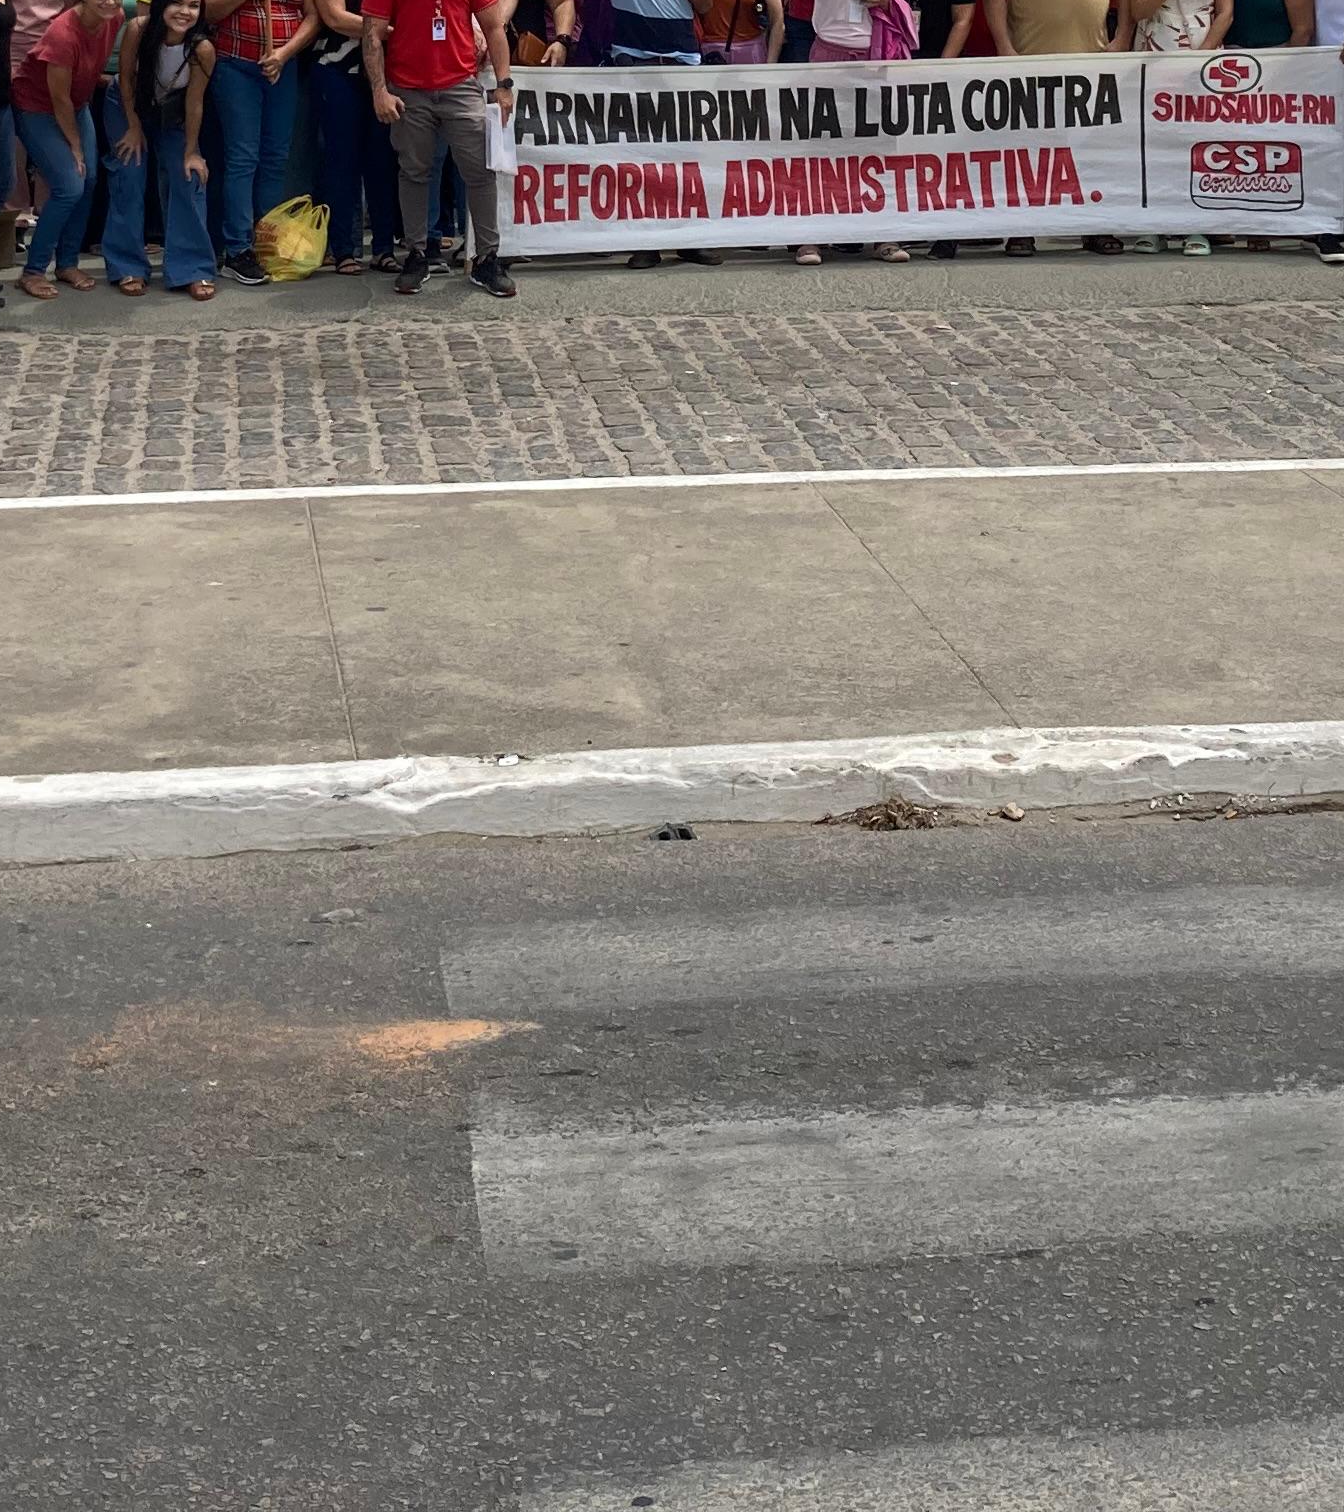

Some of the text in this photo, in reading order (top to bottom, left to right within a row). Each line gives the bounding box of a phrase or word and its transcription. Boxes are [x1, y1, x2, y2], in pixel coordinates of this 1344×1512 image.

[487, 73, 1123, 146] ARNAMIRIM NA LUTA CONTRA
[513, 146, 1104, 226] REFORMA ADMINISTRATIVA.
[1203, 143, 1290, 174] CSP
